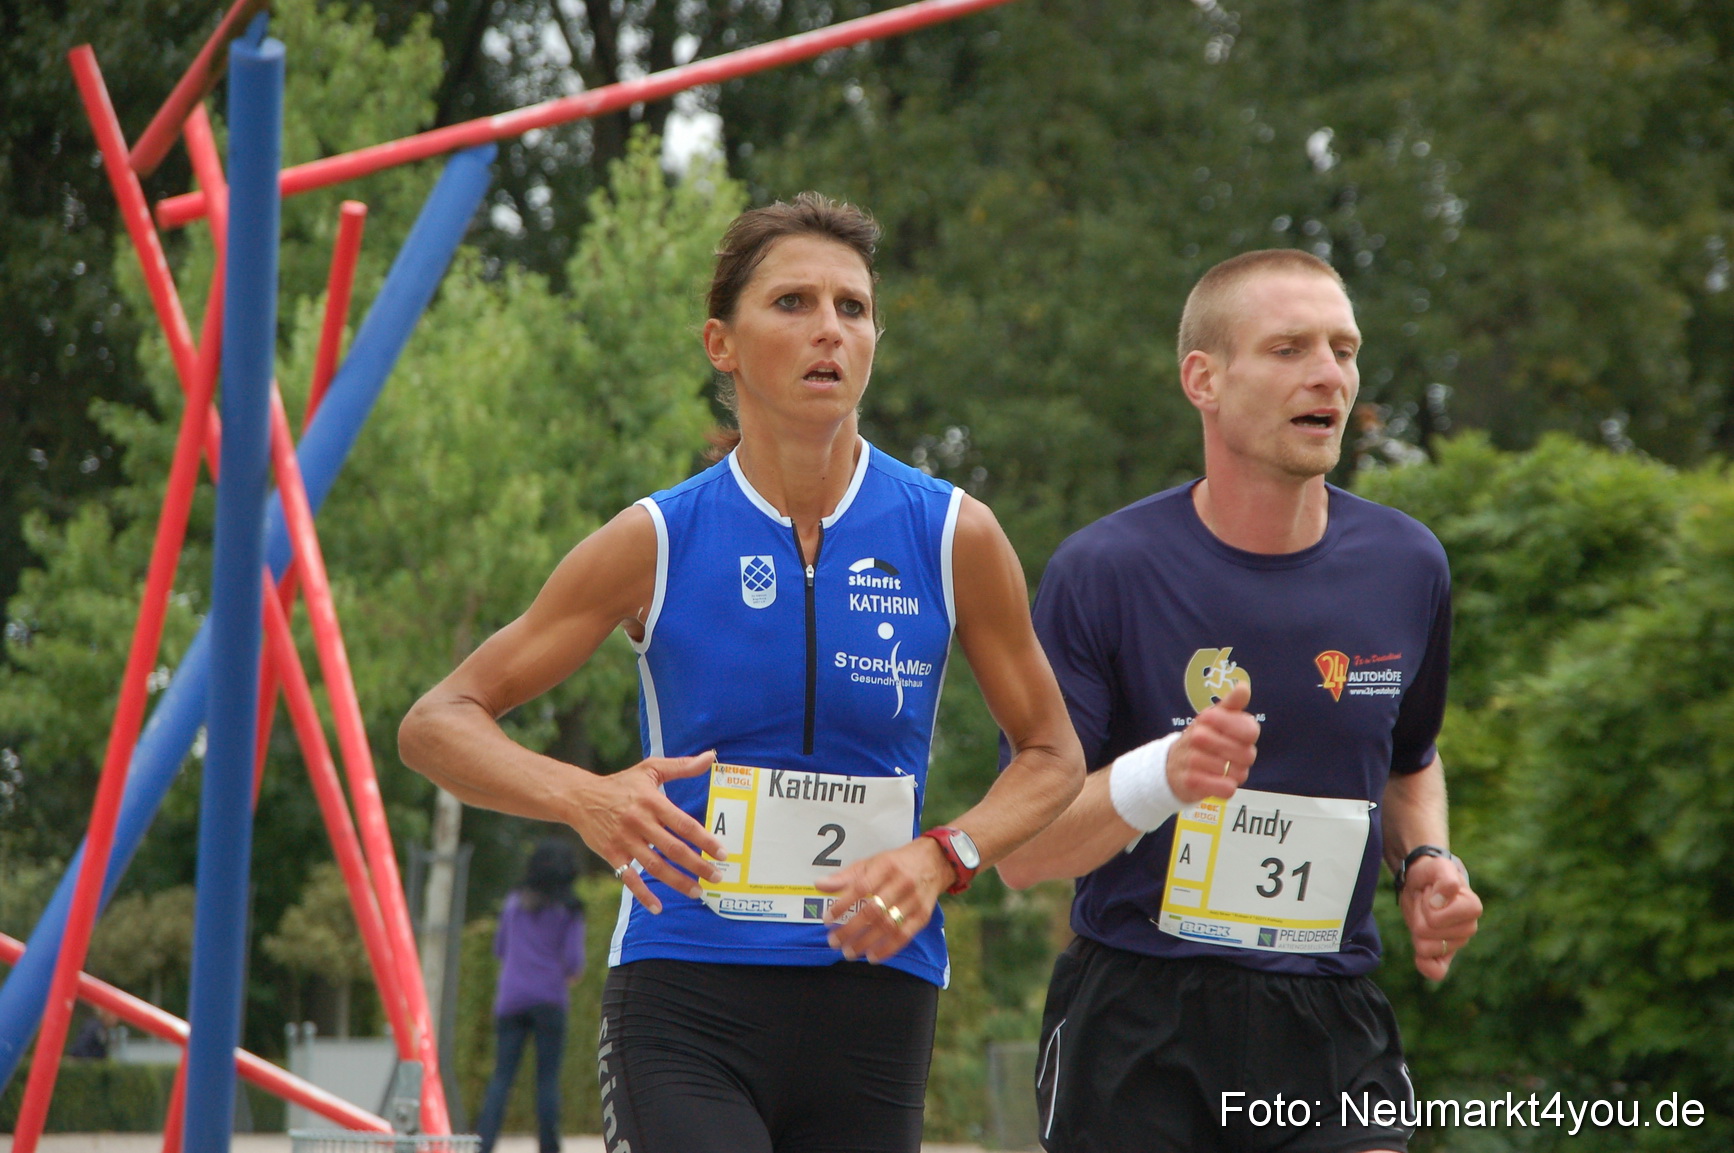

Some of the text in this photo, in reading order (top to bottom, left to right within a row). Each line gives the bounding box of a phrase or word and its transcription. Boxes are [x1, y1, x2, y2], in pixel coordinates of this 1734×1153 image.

[848, 575, 901, 590] skinfit
[849, 593, 919, 615] KATHRIN
[1348, 669, 1402, 682] AUTOHÖFE
[1172, 717, 1185, 726] Via
[768, 769, 866, 804] Kathrin
[714, 812, 726, 835] A
[1232, 805, 1293, 844] Andy
[812, 823, 846, 867] 2
[1179, 843, 1191, 864] A
[1256, 857, 1312, 901] 31
[720, 898, 773, 912] BOCK
[1180, 921, 1231, 937] BOCK
[1280, 929, 1339, 943] PFLEIDERER
